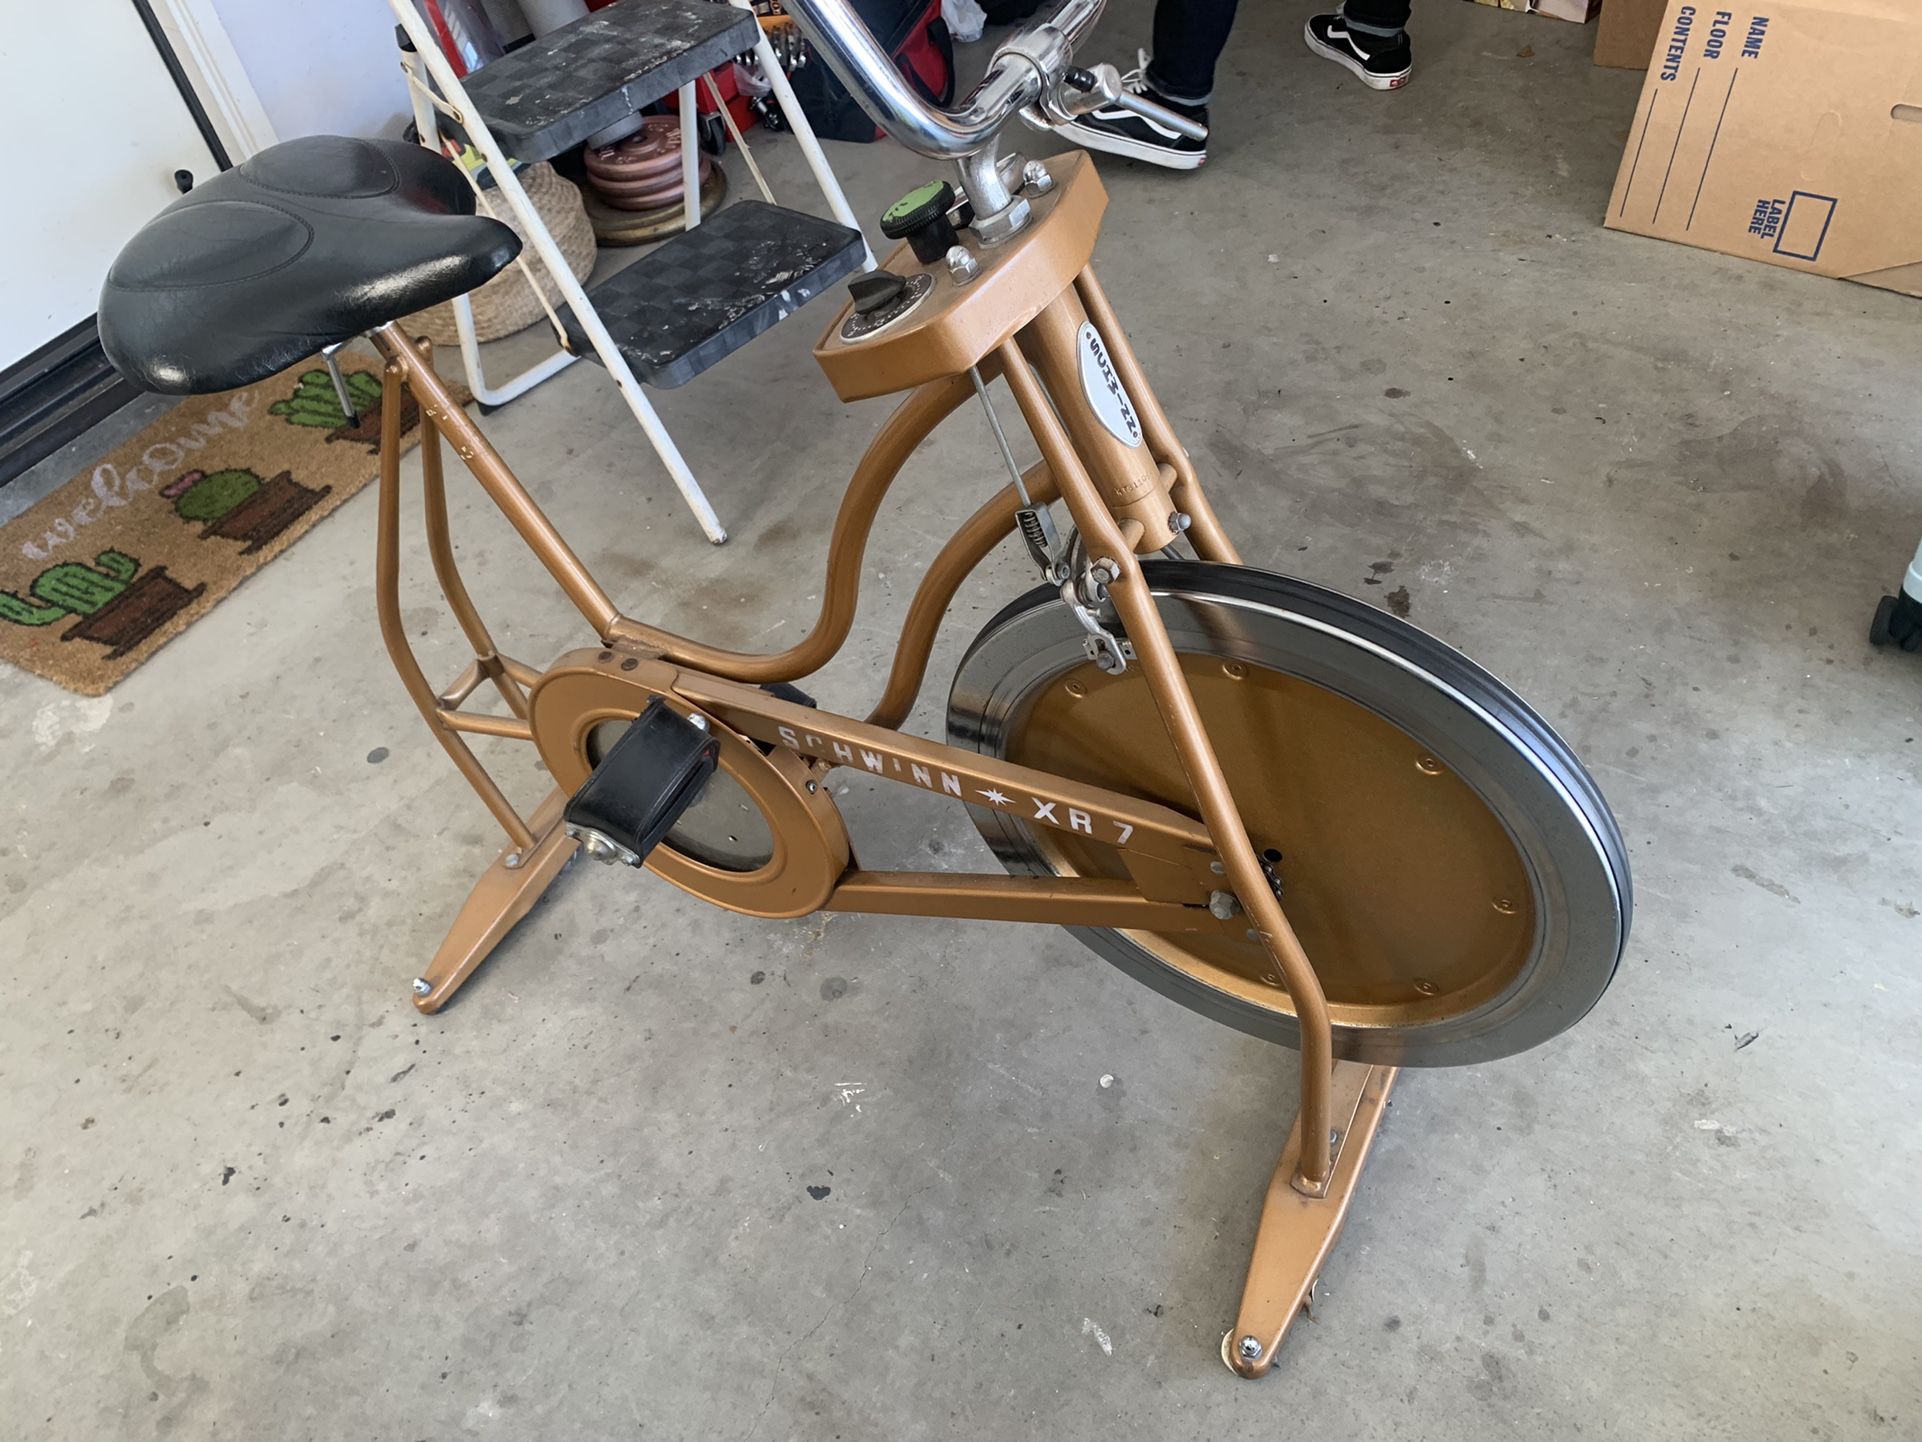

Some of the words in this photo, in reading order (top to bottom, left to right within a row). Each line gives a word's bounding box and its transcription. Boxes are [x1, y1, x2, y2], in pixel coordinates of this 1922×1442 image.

[1660, 6, 1696, 81] CONTENTS
[1703, 11, 1732, 60] FLOOR
[1741, 16, 1769, 59] NAME
[1748, 199, 1770, 234] HERE
[1760, 199, 1786, 239] LABEL
[1090, 338, 1136, 433] SCHWINN
[1112, 821, 1134, 844] 7
